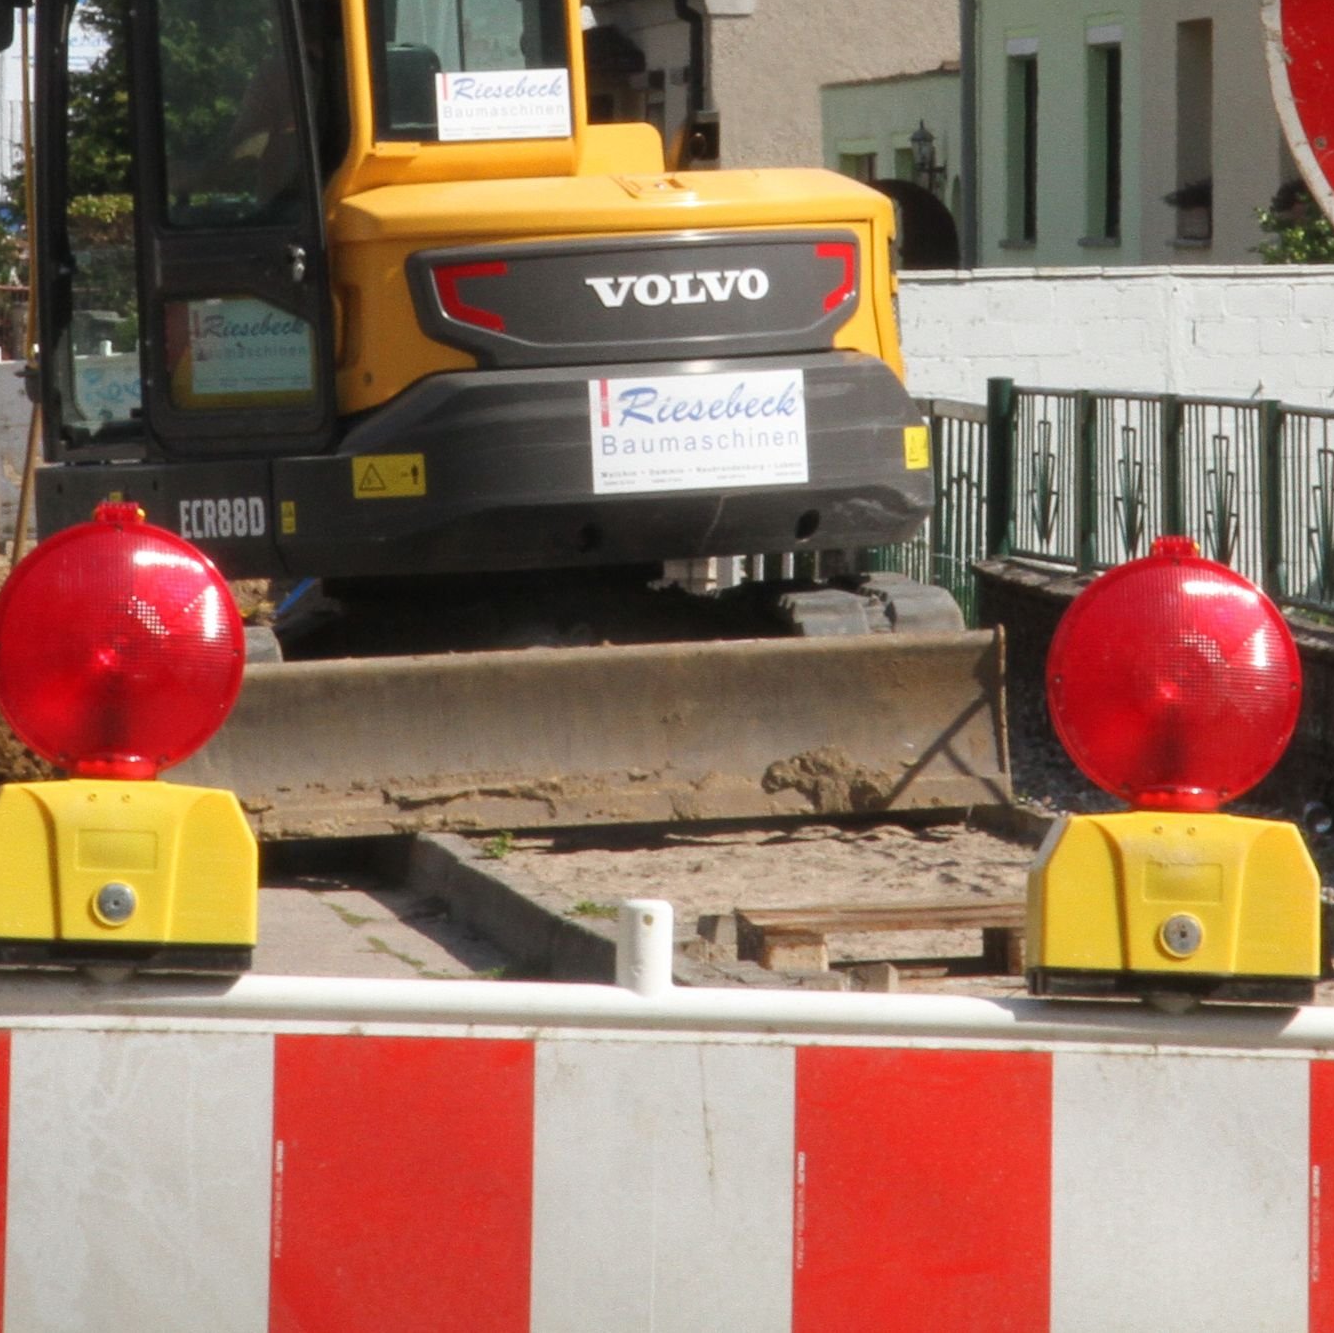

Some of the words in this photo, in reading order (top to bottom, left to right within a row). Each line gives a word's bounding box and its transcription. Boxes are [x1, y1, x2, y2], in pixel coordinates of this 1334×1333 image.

[453, 75, 563, 100] Riesebeck
[443, 105, 565, 118] Baumaschinen
[585, 268, 769, 308] VOLVO
[619, 381, 797, 427] Riesebeck
[601, 428, 799, 456] Baumaschinen
[179, 496, 265, 539] ECR88D
